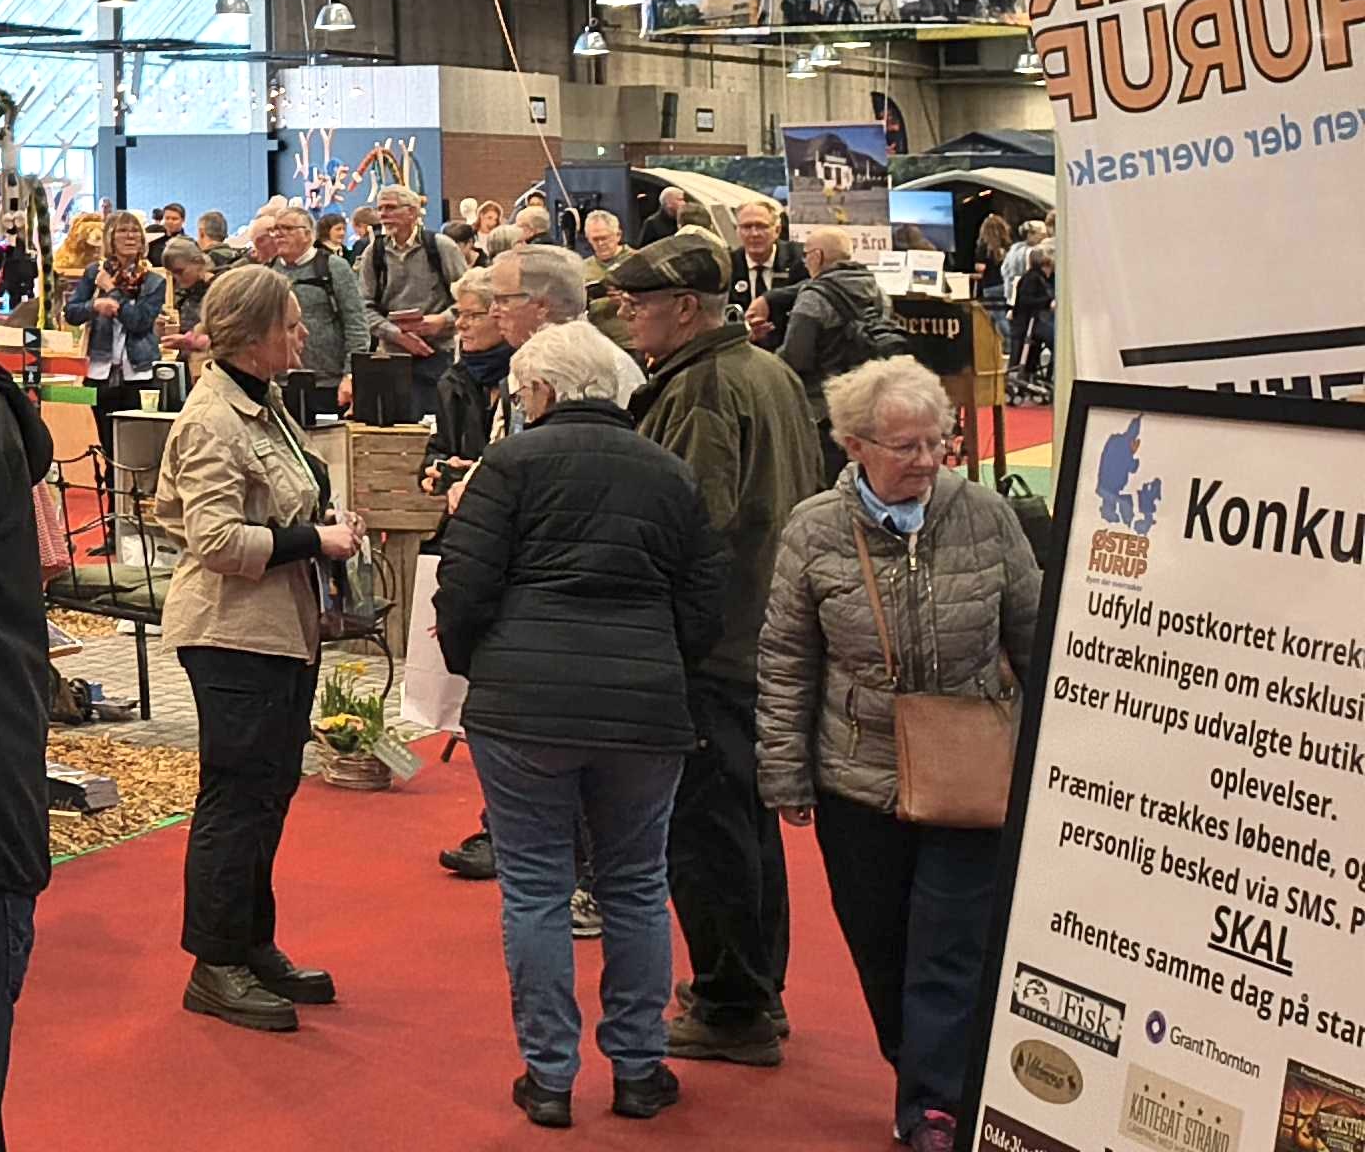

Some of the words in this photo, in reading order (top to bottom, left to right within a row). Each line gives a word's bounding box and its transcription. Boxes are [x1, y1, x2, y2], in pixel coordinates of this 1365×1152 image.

[1088, 548, 1148, 579] HURUP
[1092, 529, 1150, 558] ØSTER
[1088, 591, 1153, 629] Udfyld
[1157, 607, 1277, 652] postkortet
[1066, 632, 1219, 689] lodtrækningen
[1224, 671, 1260, 699] om
[1053, 675, 1110, 712] Øster
[1114, 688, 1189, 735] Hurups
[1194, 712, 1293, 757] udvalgte
[1048, 765, 1135, 812] Præmier
[1140, 792, 1230, 842] trækkes
[1235, 818, 1336, 878] løbende,
[1210, 766, 1338, 821] oplevelser.
[1059, 819, 1156, 876] personlig
[1160, 844, 1240, 895] besked
[1245, 876, 1280, 909] via
[1285, 886, 1341, 930] SMS.
[1210, 904, 1294, 968] SKAL
[1050, 910, 1141, 962] afhentes
[1144, 945, 1225, 995] samme
[1231, 974, 1274, 1020] dag
[1278, 993, 1309, 1027] på
[1063, 991, 1112, 1038] Fisk
[1129, 1092, 1183, 1141] KATTEGAT
[1183, 1116, 1230, 1152] STRAND
